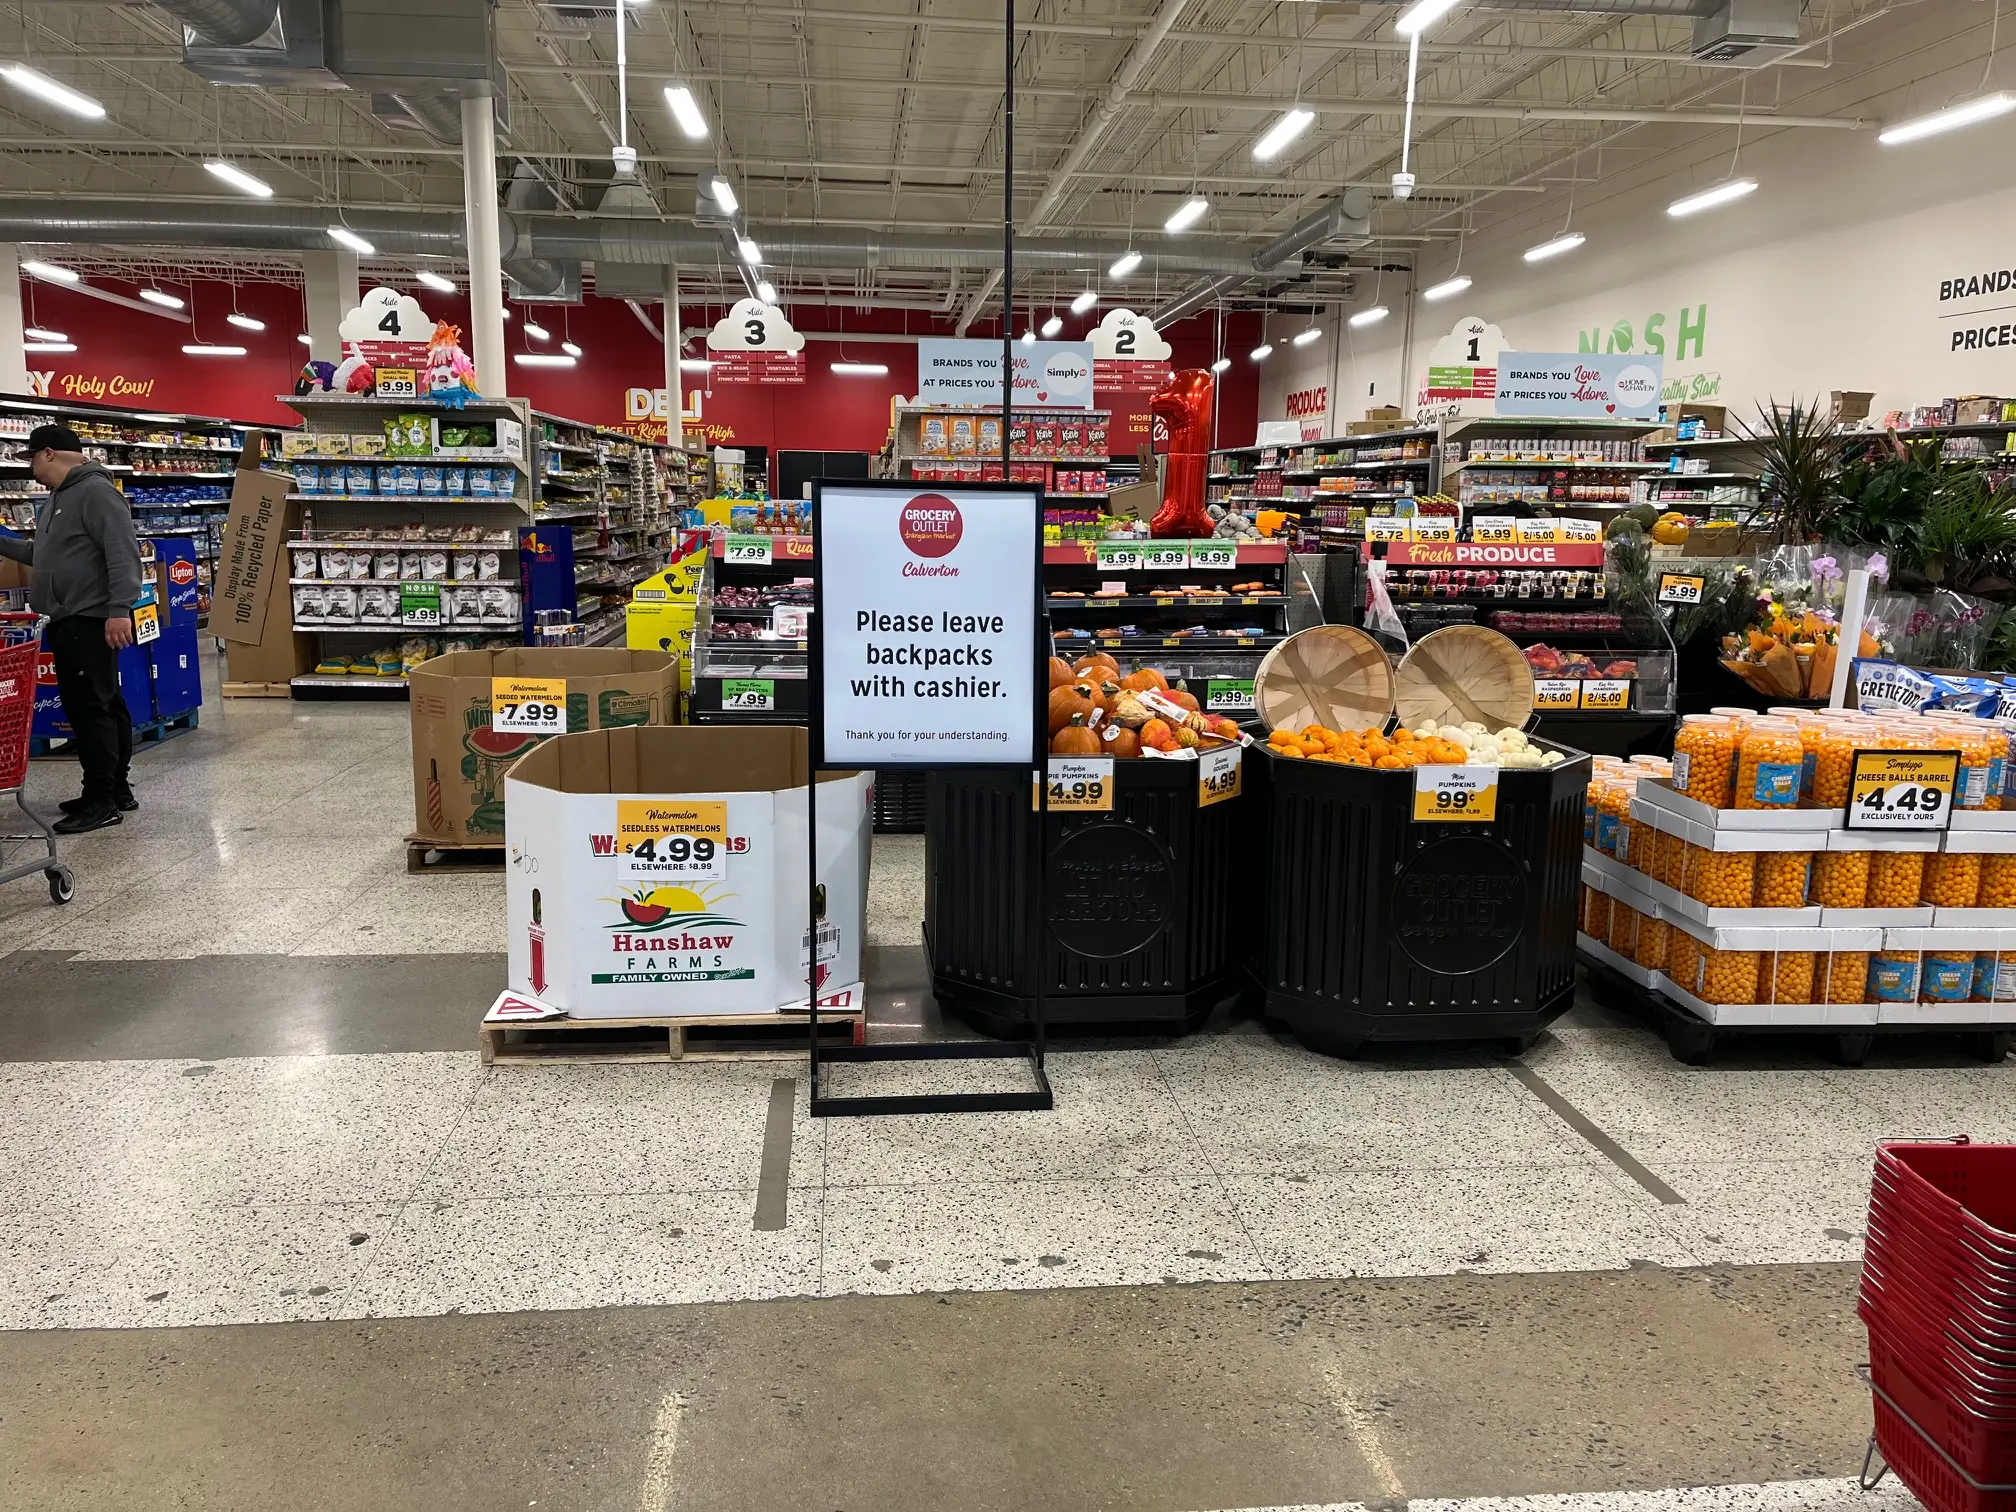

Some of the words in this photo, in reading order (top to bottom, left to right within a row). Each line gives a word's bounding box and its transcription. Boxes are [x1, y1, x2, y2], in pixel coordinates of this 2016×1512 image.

[378, 310, 401, 336] 4
[744, 320, 766, 345] 3
[1115, 329, 1136, 354] 2
[1467, 337, 1480, 361] 1
[932, 359, 973, 368] BRANDS
[976, 360, 997, 368] YOU
[1047, 368, 1080, 379] Simply
[1510, 371, 1548, 380] BRANDS
[1552, 372, 1571, 380] YOU
[1574, 365, 1601, 384] Love,
[61, 375, 106, 399] Holy
[109, 375, 154, 397] Cow!
[379, 381, 413, 391] $9.99
[923, 379, 935, 387] AT
[938, 379, 973, 387] PRICES
[975, 380, 995, 388] YOU
[1660, 379, 1688, 403] ealthy
[1690, 373, 1721, 400] Start
[1500, 391, 1511, 399] AT
[1514, 391, 1546, 399] PRICES
[1548, 392, 1567, 400] YOU
[1570, 385, 1609, 401] Adore.
[1286, 386, 1327, 417] PRODUCE
[705, 424, 736, 442] High.
[253, 495, 273, 532] Paper
[905, 509, 956, 521] GROCERY
[236, 515, 250, 539] From
[912, 521, 950, 532] OUTLET
[904, 531, 932, 542] bargain
[933, 531, 956, 540] market
[1371, 530, 1404, 540] $2.72
[1417, 530, 1450, 540] $2.99
[1478, 529, 1511, 539] $2.99
[1523, 531, 1555, 540] 2/$5.00
[1565, 531, 1596, 541] 2/$5.00
[231, 540, 246, 565] Made
[730, 546, 766, 557] $7.99
[1101, 553, 1136, 563] $8.99
[1148, 552, 1183, 563] $8.99
[1195, 552, 1230, 562] $8.99
[1408, 544, 1454, 563] Fresh
[1456, 547, 1556, 562] PRODUCE
[242, 530, 266, 590] Recycled
[171, 567, 193, 580] Lipton
[902, 562, 960, 577] Calverton
[225, 563, 243, 599] Display
[1664, 584, 1697, 597] $5.99
[235, 591, 254, 624] 100%
[405, 610, 437, 619] $9.99
[138, 620, 156, 636] $1.99
[856, 610, 934, 633] Please
[942, 611, 1004, 633] leave
[866, 643, 993, 670] backpacks
[850, 675, 905, 698] with
[913, 676, 1007, 698] cashier.
[729, 693, 767, 704] $7.99
[1210, 692, 1253, 703] $9.99/LB
[1538, 693, 1571, 703] 2/$5.00
[1588, 693, 1621, 703] 2/$5.00
[499, 704, 558, 720] $7.99
[846, 730, 875, 740] Thank
[877, 732, 896, 742] you
[898, 730, 910, 740] for
[914, 732, 936, 742] your
[938, 730, 1010, 743] understanding.
[1886, 758, 1924, 771] Simplygo
[1204, 770, 1236, 791] $4.99
[1856, 773, 1886, 782] CHEESE
[1888, 774, 1915, 782] BALLS
[1917, 774, 1951, 782] BARREL
[1050, 782, 1103, 799] 4.99
[1436, 791, 1475, 808] 99¢
[1856, 787, 1943, 812] $4.49
[646, 809, 699, 821] Watermelon
[621, 825, 660, 833] SEEDLESS
[662, 825, 721, 833] WATERMELONS
[625, 838, 715, 862] $4.99
[612, 933, 733, 952] Hanshaw
[627, 955, 722, 969] FARMS
[612, 974, 657, 983] FAMILY
[662, 972, 708, 981] OWNED
